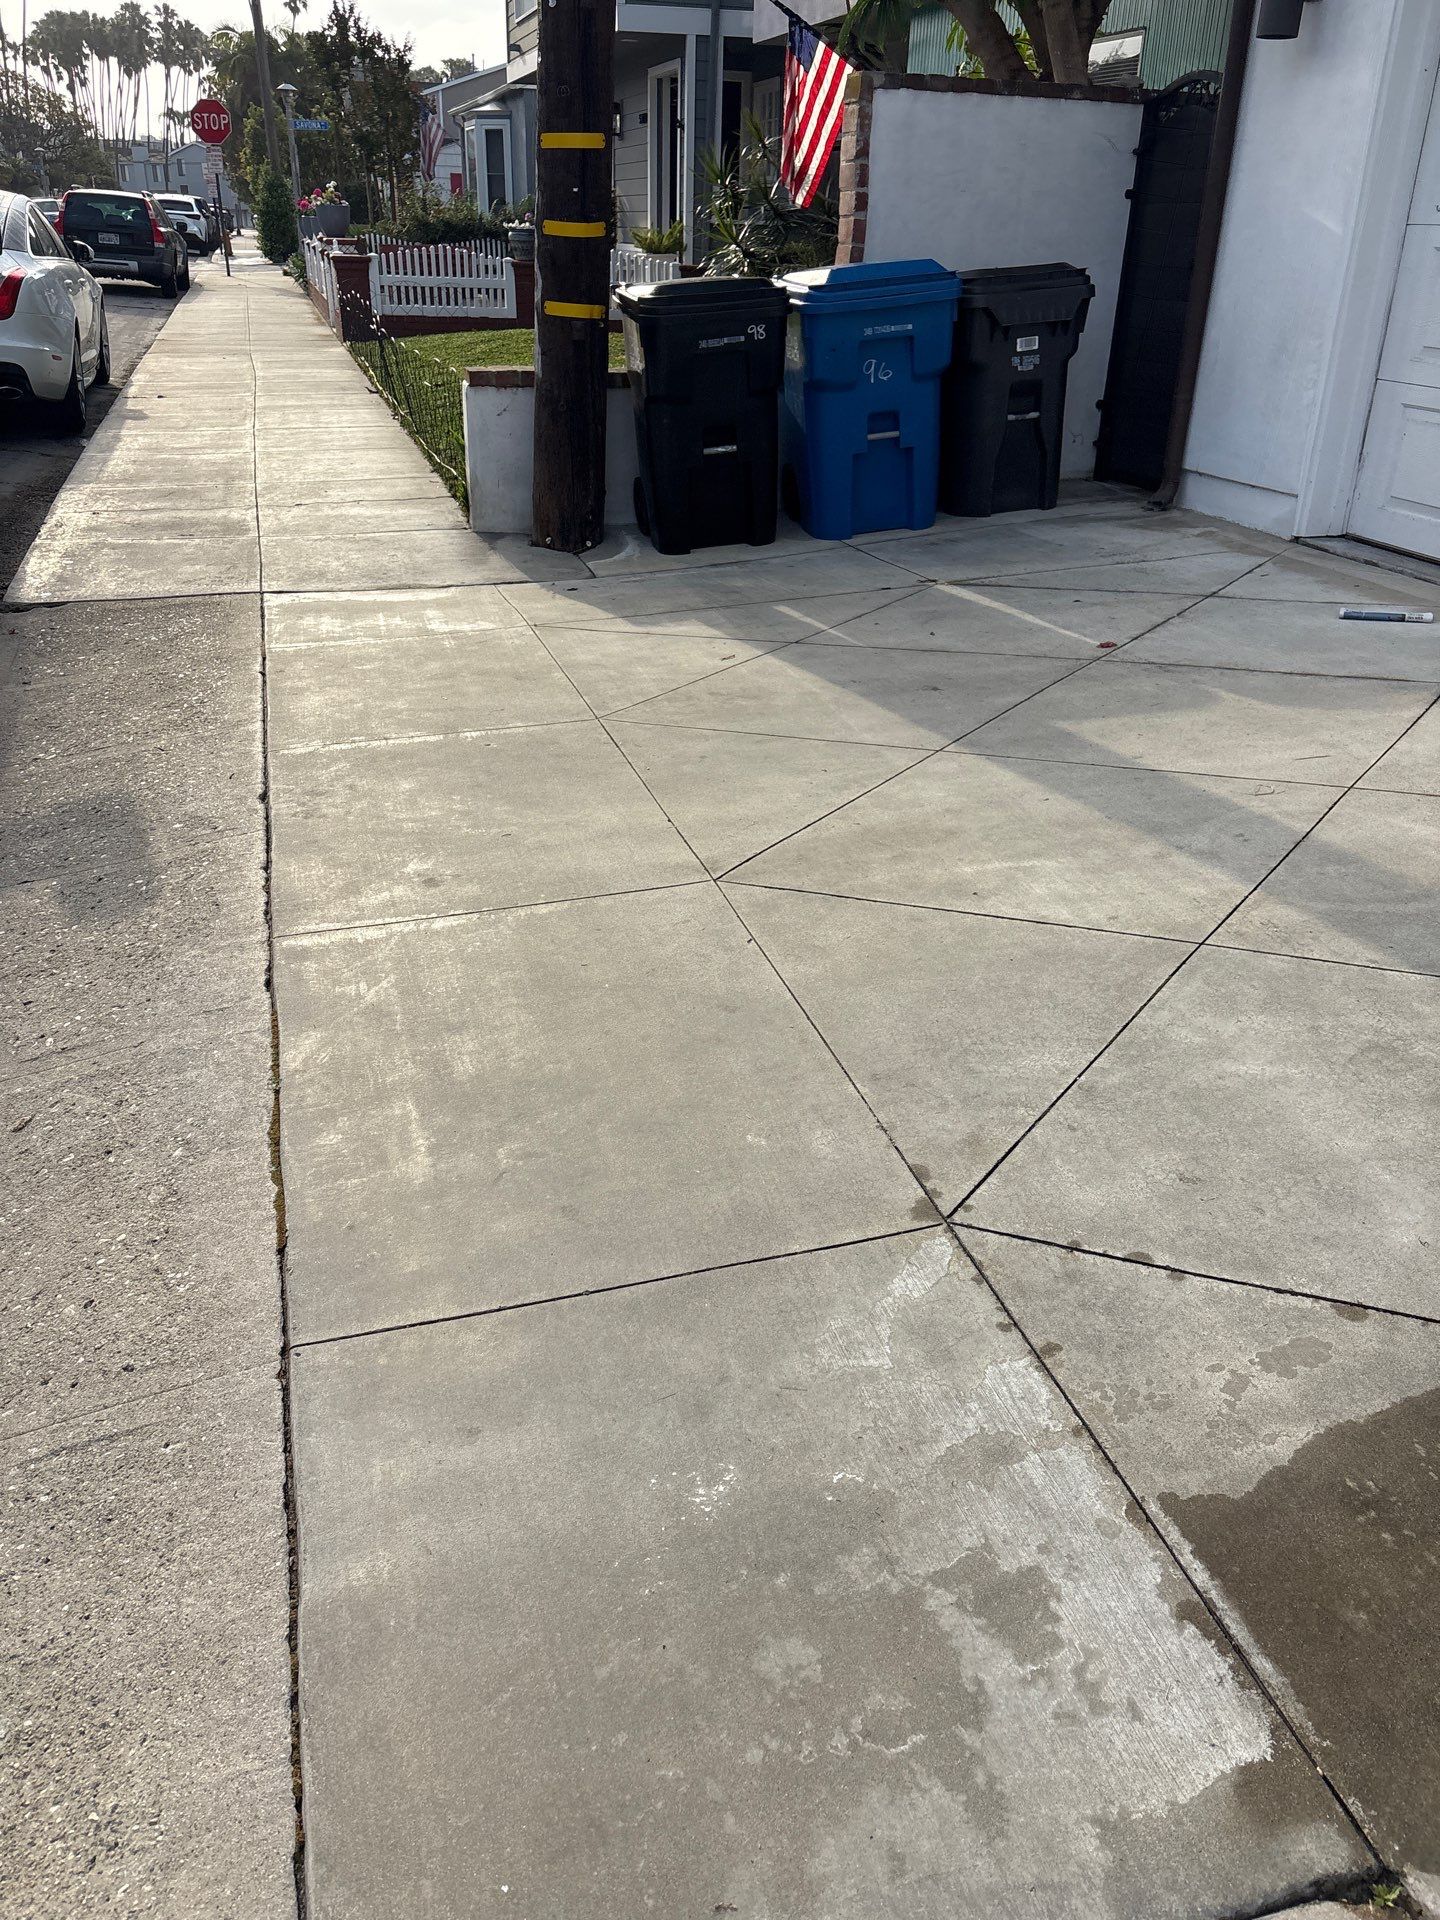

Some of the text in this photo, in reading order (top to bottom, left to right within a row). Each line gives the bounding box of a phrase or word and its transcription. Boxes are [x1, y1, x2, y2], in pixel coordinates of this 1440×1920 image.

[193, 113, 229, 131] STOP
[295, 120, 321, 129] SAVONA
[747, 324, 767, 341] 98
[862, 358, 893, 384] 96
